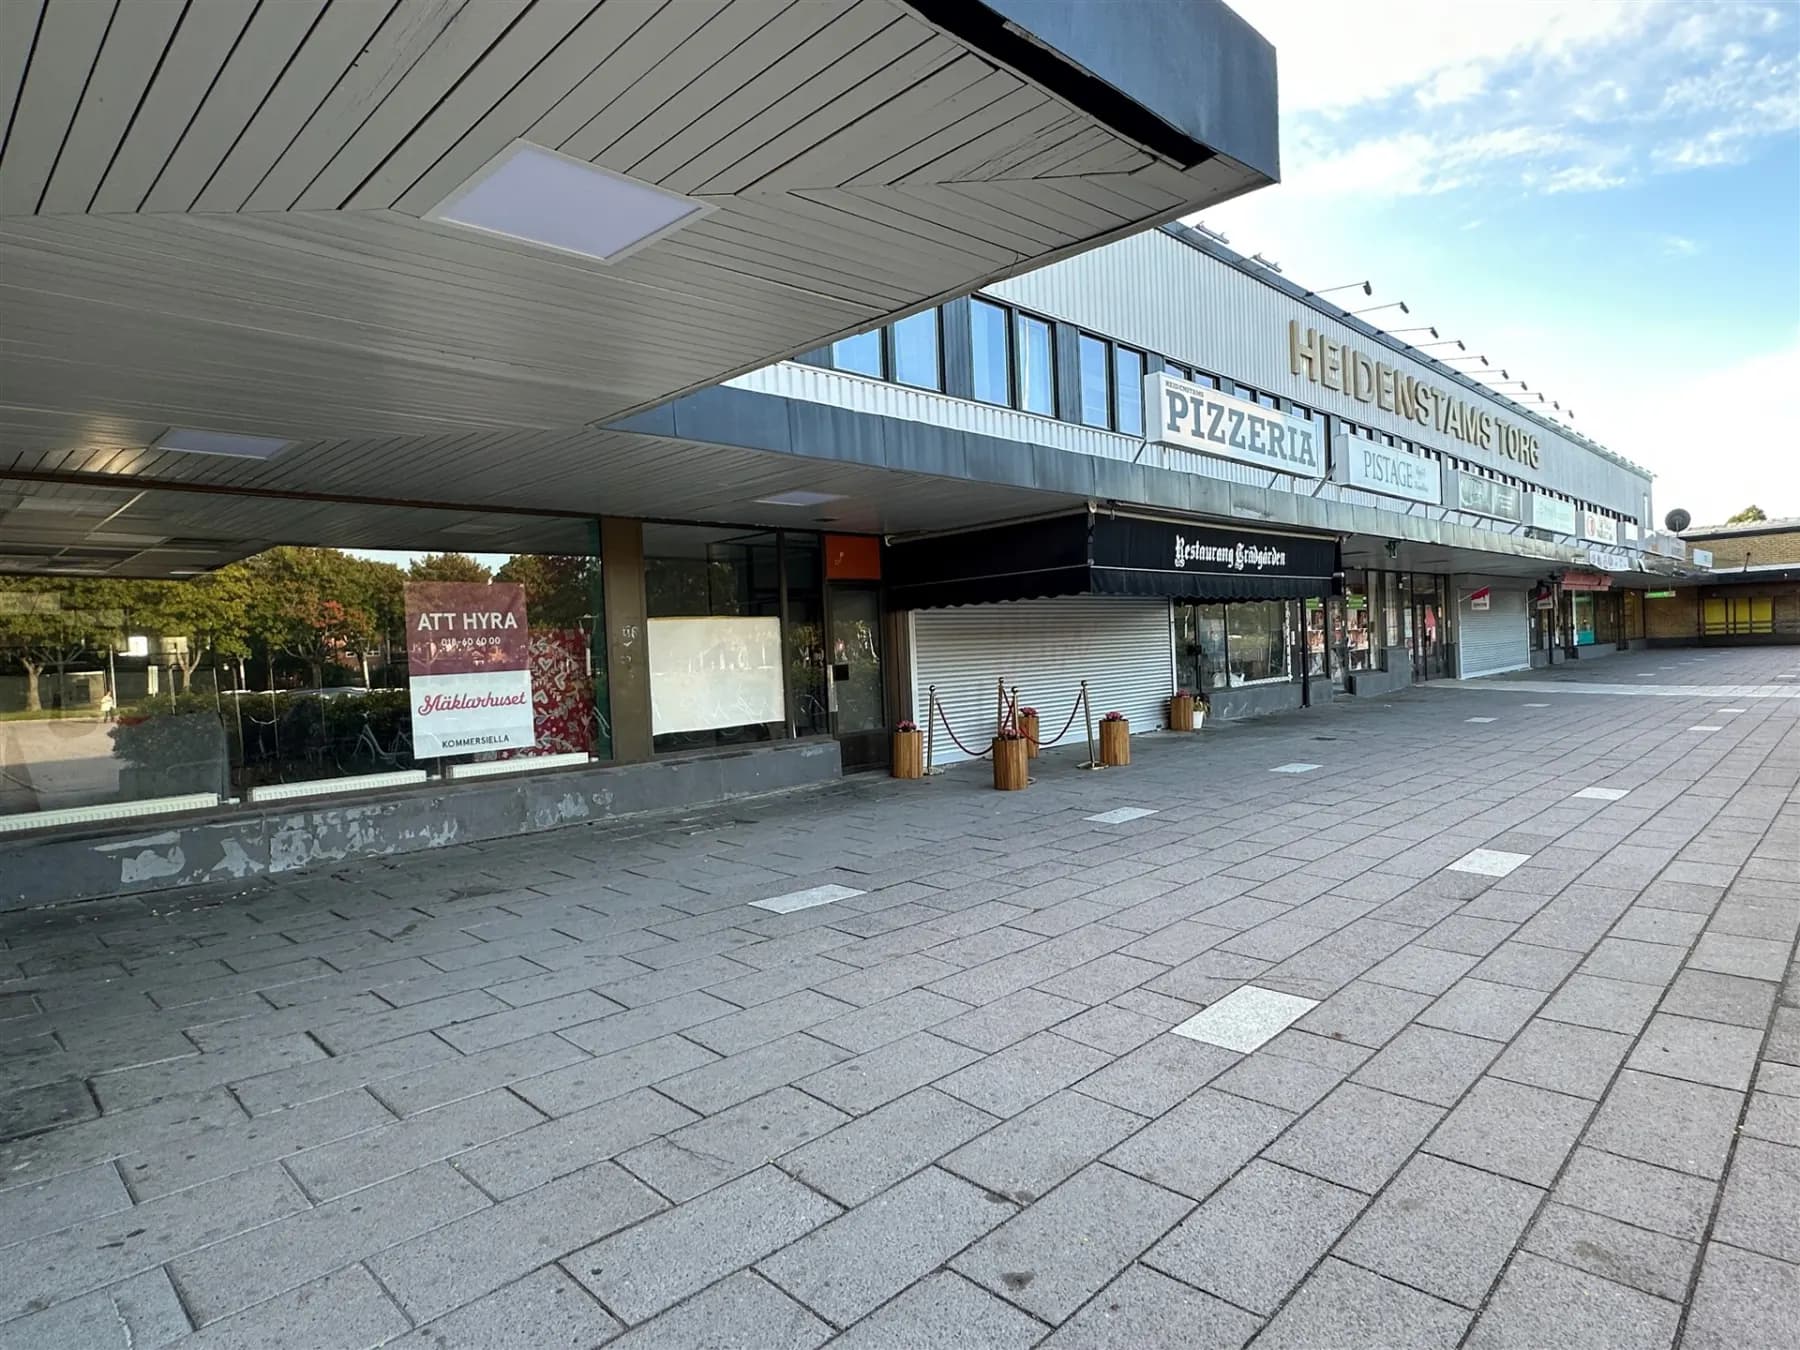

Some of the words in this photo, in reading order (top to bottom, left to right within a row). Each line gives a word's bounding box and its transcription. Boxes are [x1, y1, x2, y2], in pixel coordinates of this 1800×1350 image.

[1289, 319, 1492, 450] HEIDENSTAMS
[1495, 416, 1539, 470] TORG
[1165, 388, 1316, 467] PIZZERIA
[1174, 534, 1234, 568] Restaurang
[417, 613, 456, 631] ATT
[463, 612, 518, 630] HYRA
[488, 636, 501, 645] 00
[418, 691, 527, 716] Mäklarhuset
[442, 734, 510, 748] KOMMERSIELLA
